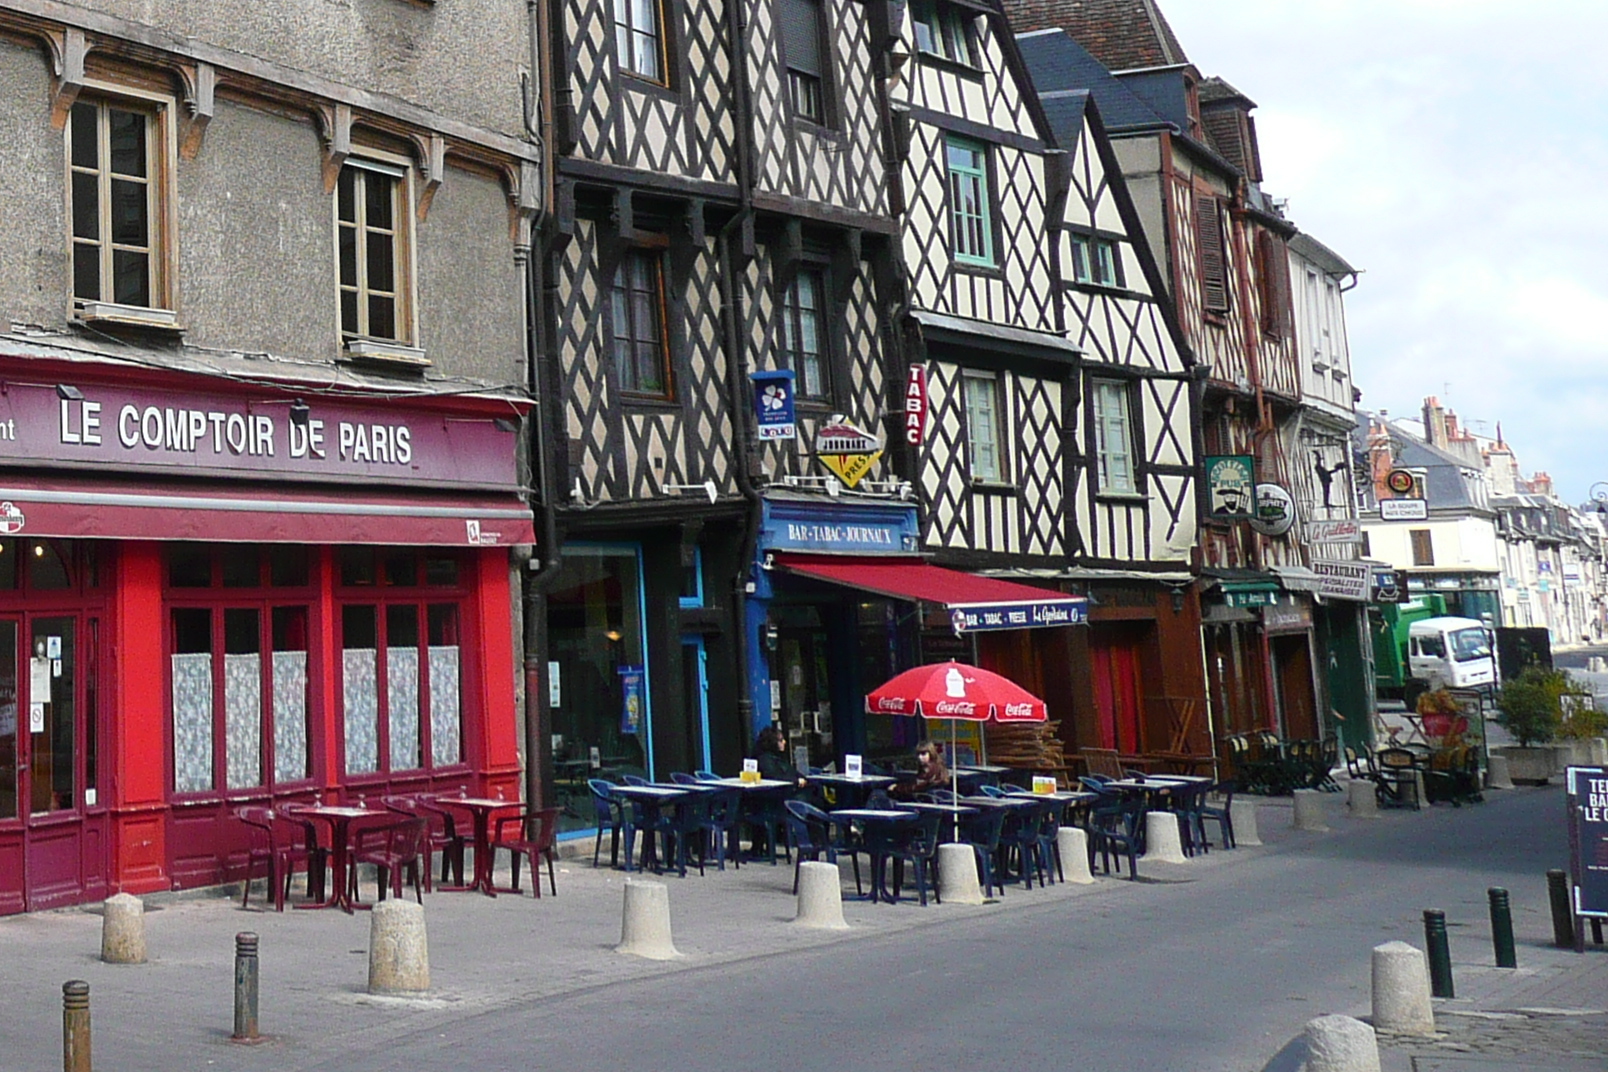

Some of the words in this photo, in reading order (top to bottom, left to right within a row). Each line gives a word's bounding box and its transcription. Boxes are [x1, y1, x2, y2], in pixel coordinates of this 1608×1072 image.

[906, 367, 922, 443] TABAC
[59, 400, 102, 446] LE
[118, 403, 275, 457] COMPTOIR
[290, 417, 324, 459] DE
[339, 422, 412, 465] PARIS
[1314, 563, 1366, 580] RESTAURANT
[1318, 577, 1365, 589] PECIALITES
[936, 701, 976, 715] Coca-Cola
[1005, 703, 1033, 716] Coca-Cola
[1585, 807, 1601, 821] LE
